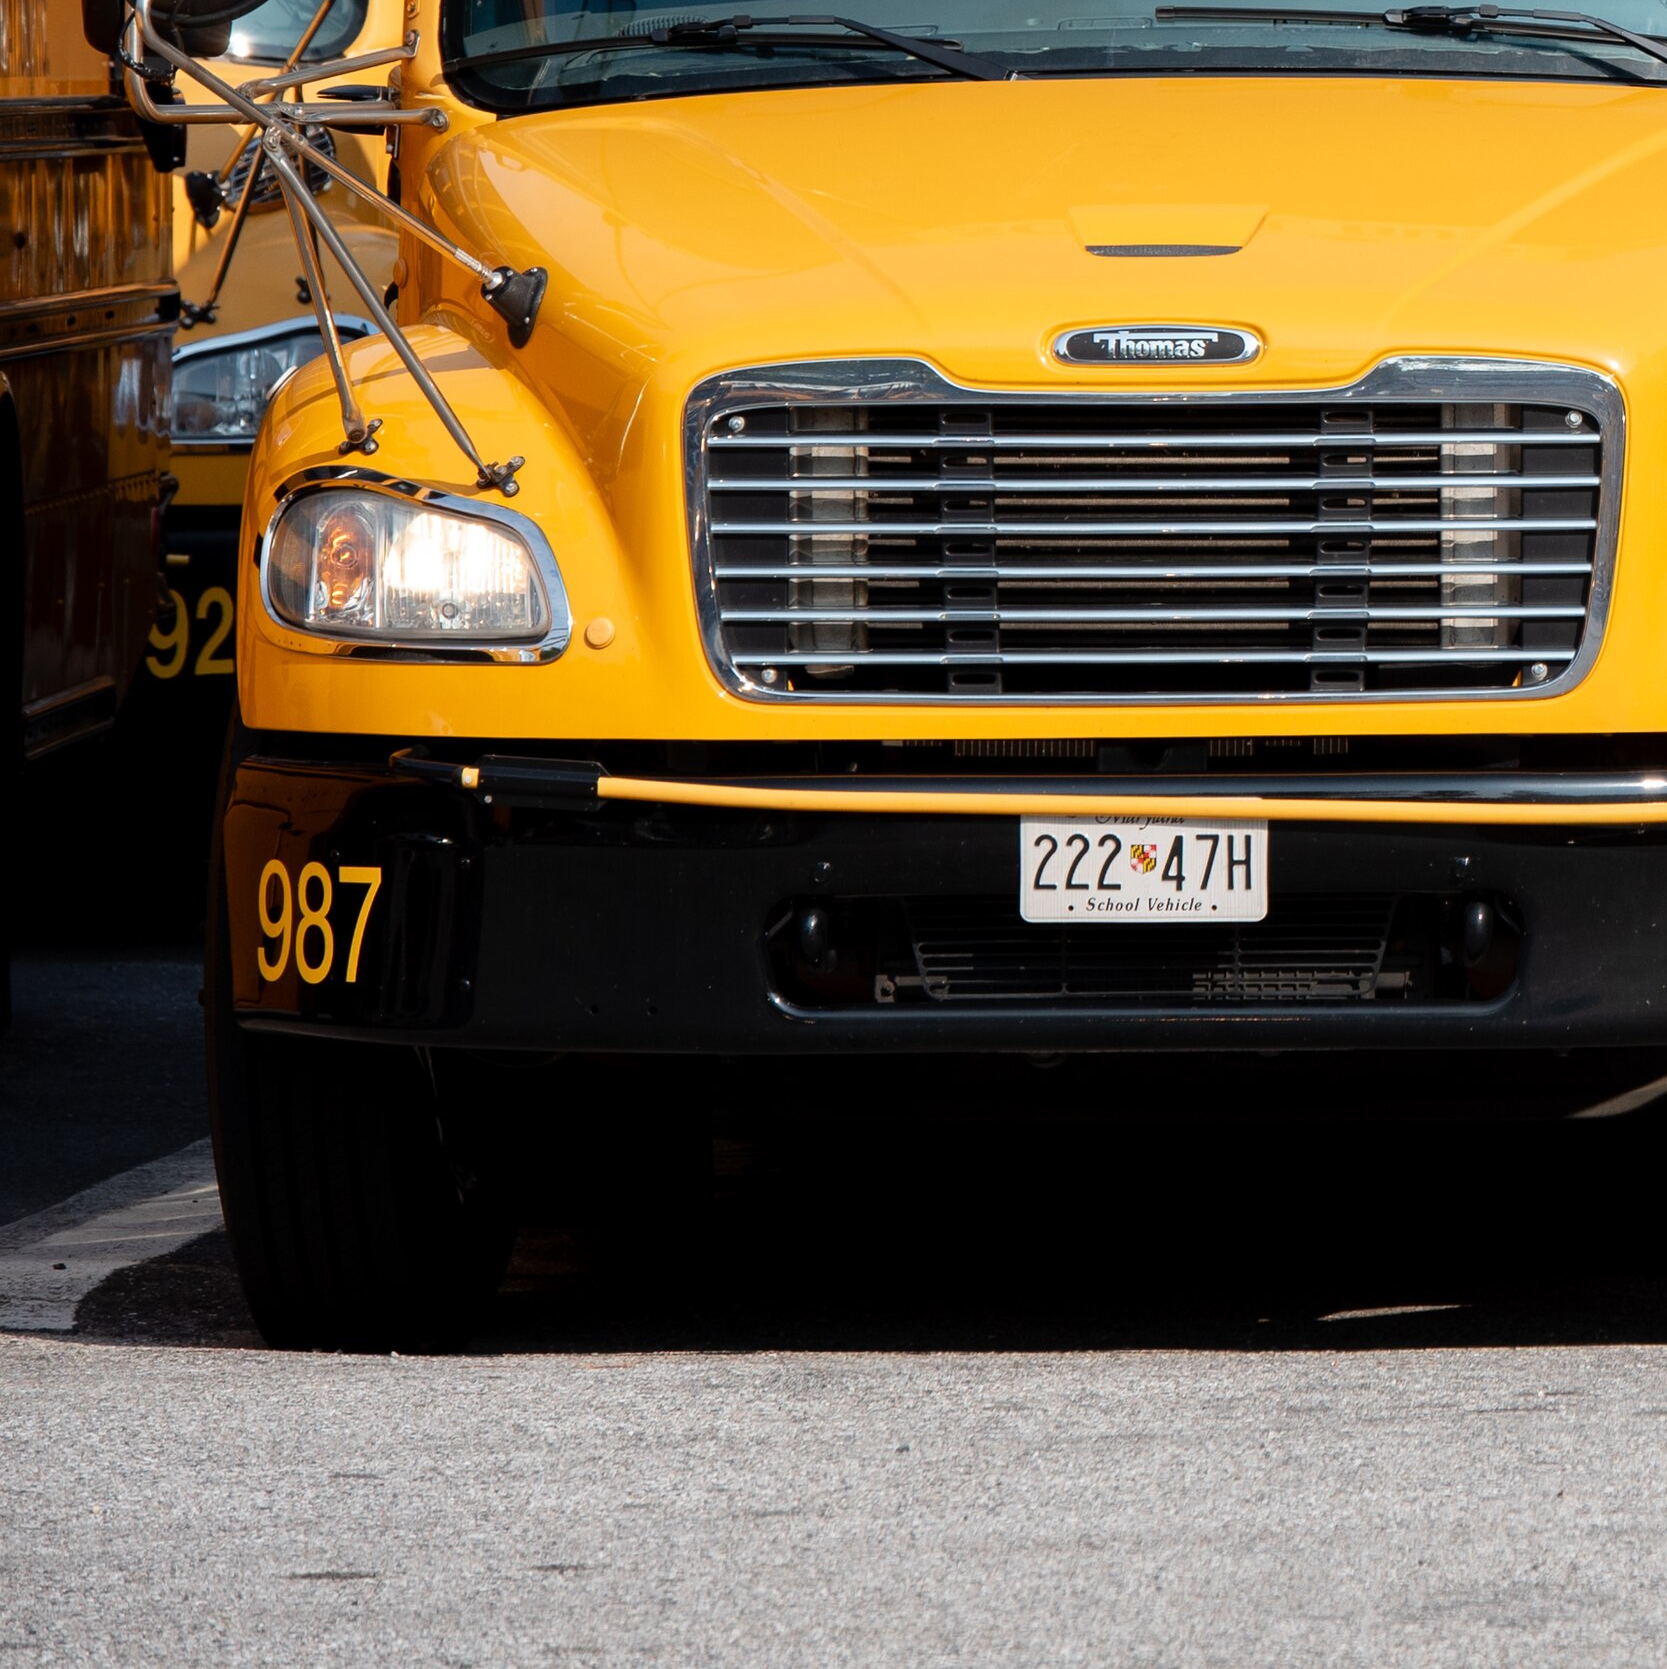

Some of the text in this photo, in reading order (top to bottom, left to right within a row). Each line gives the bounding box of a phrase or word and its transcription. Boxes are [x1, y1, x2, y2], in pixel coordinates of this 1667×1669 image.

[1093, 330, 1218, 359] Thomas
[1033, 833, 1253, 892] 222 47H
[257, 859, 383, 985] 987
[1086, 897, 1203, 912] School Vehicle
